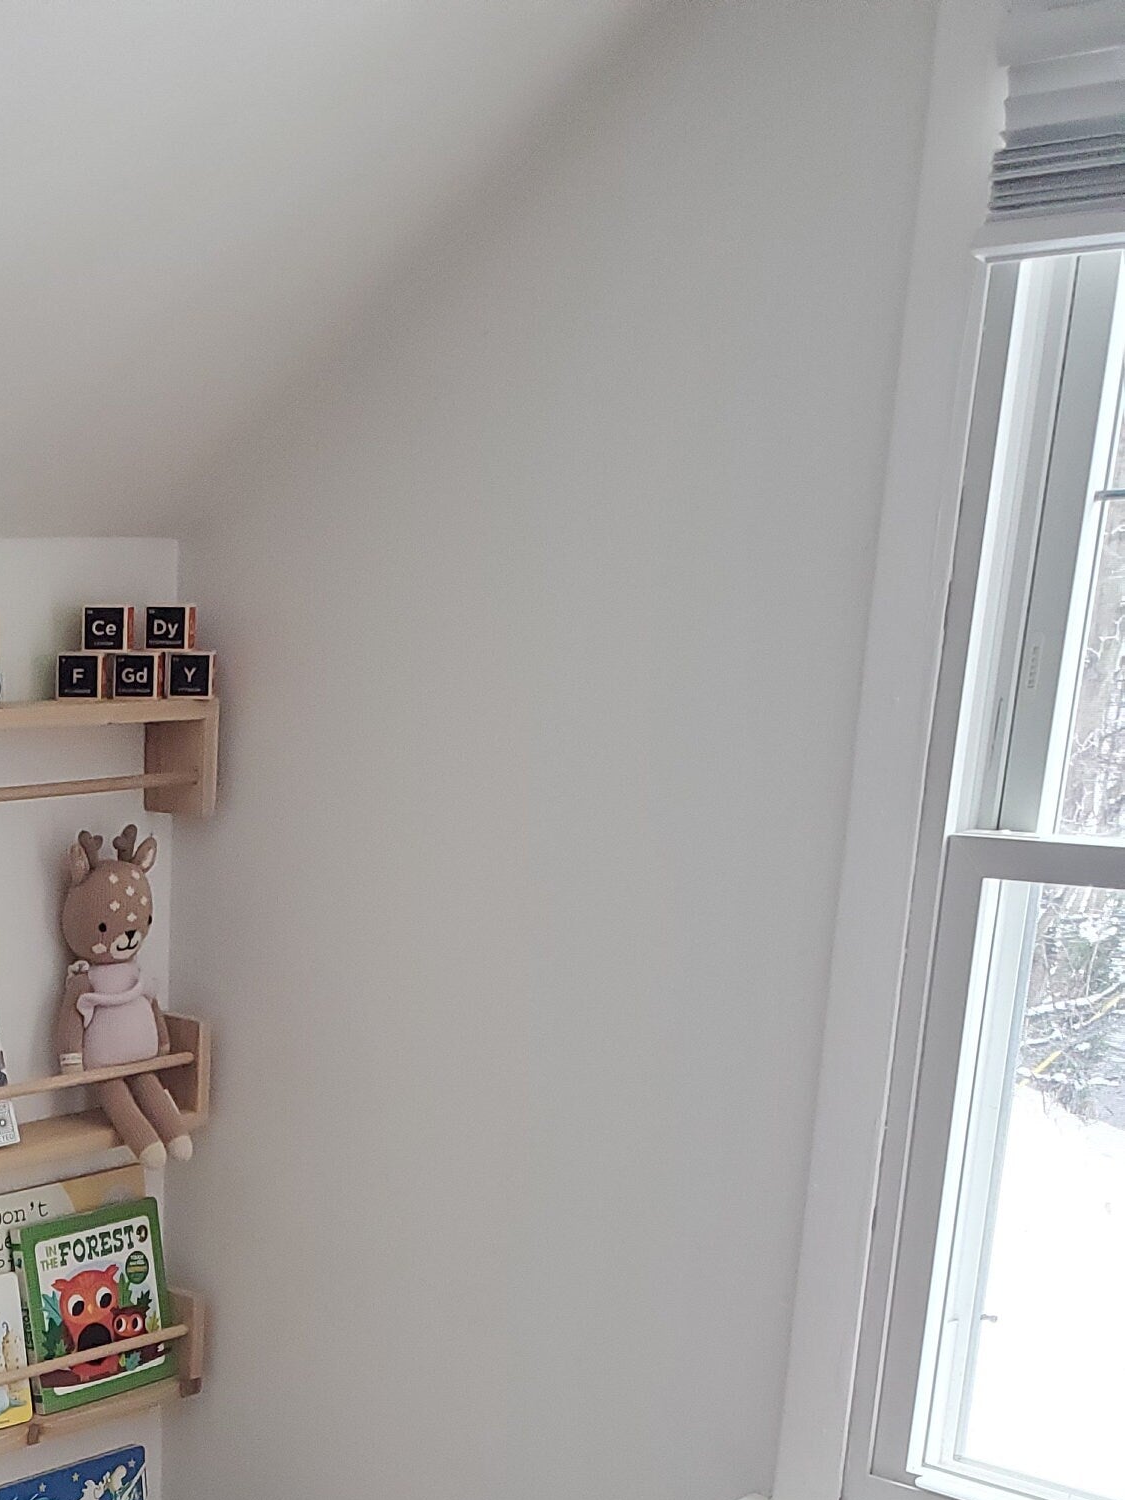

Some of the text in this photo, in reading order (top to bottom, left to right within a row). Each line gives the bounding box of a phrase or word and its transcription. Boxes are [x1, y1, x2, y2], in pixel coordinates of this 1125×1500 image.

[91, 619, 117, 636] Ce
[153, 619, 179, 639] Dy
[72, 667, 85, 684] F
[121, 666, 148, 684] Gd
[183, 666, 197, 683] Y
[45, 1243, 58, 1258] IN
[58, 1224, 135, 1267] FOREST
[40, 1257, 59, 1272] THE
